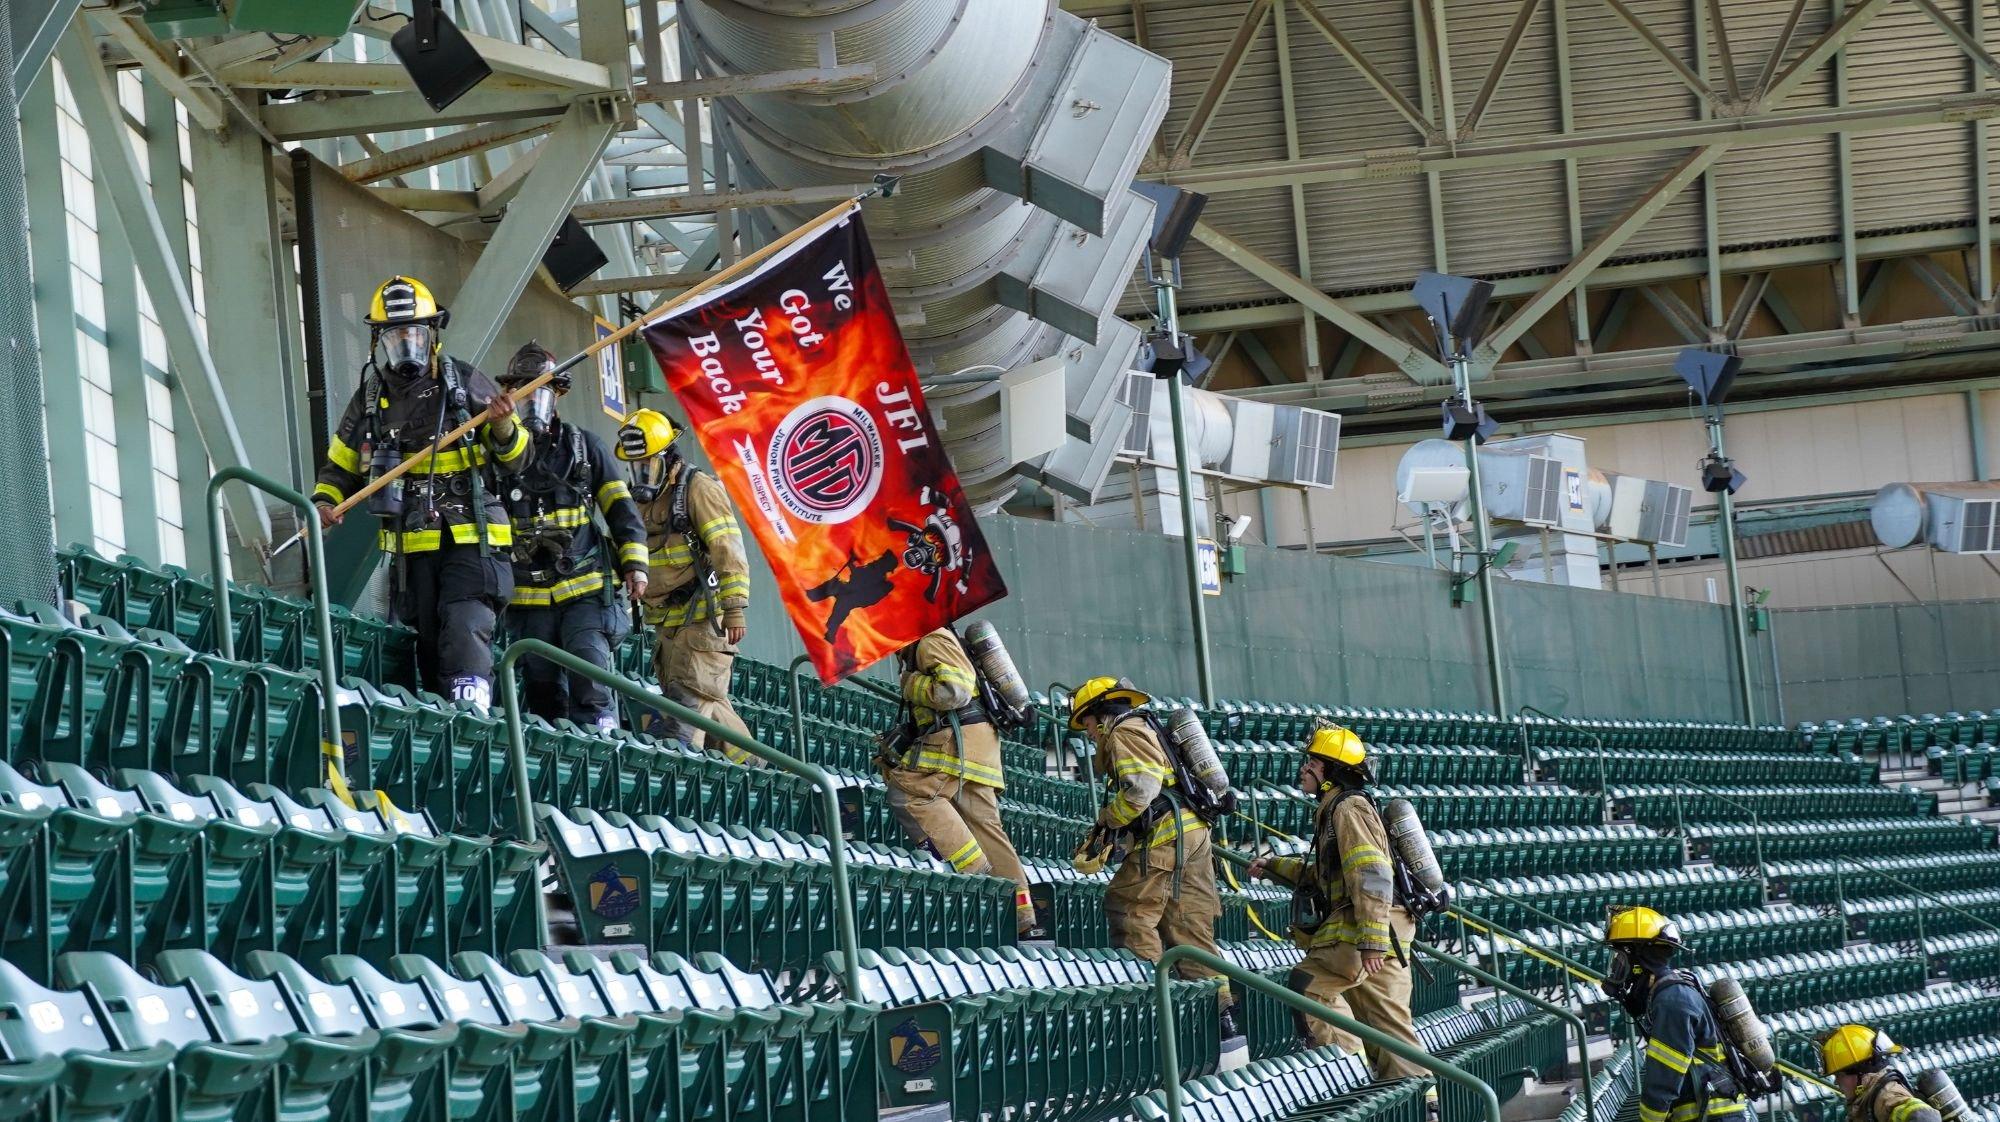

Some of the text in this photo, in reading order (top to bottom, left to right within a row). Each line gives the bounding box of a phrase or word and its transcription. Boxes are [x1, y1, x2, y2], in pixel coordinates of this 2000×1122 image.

[822, 259, 854, 311] We
[780, 288, 824, 347] Got
[687, 331, 748, 415] Back
[734, 307, 784, 385] Your
[852, 407, 881, 468] MILWAUKEE
[876, 381, 930, 455] JFI
[770, 428, 786, 466] JUNIOR
[752, 473, 773, 513] RESPECT
[770, 468, 784, 491] FIRE
[780, 491, 823, 522] INSTITUTE
